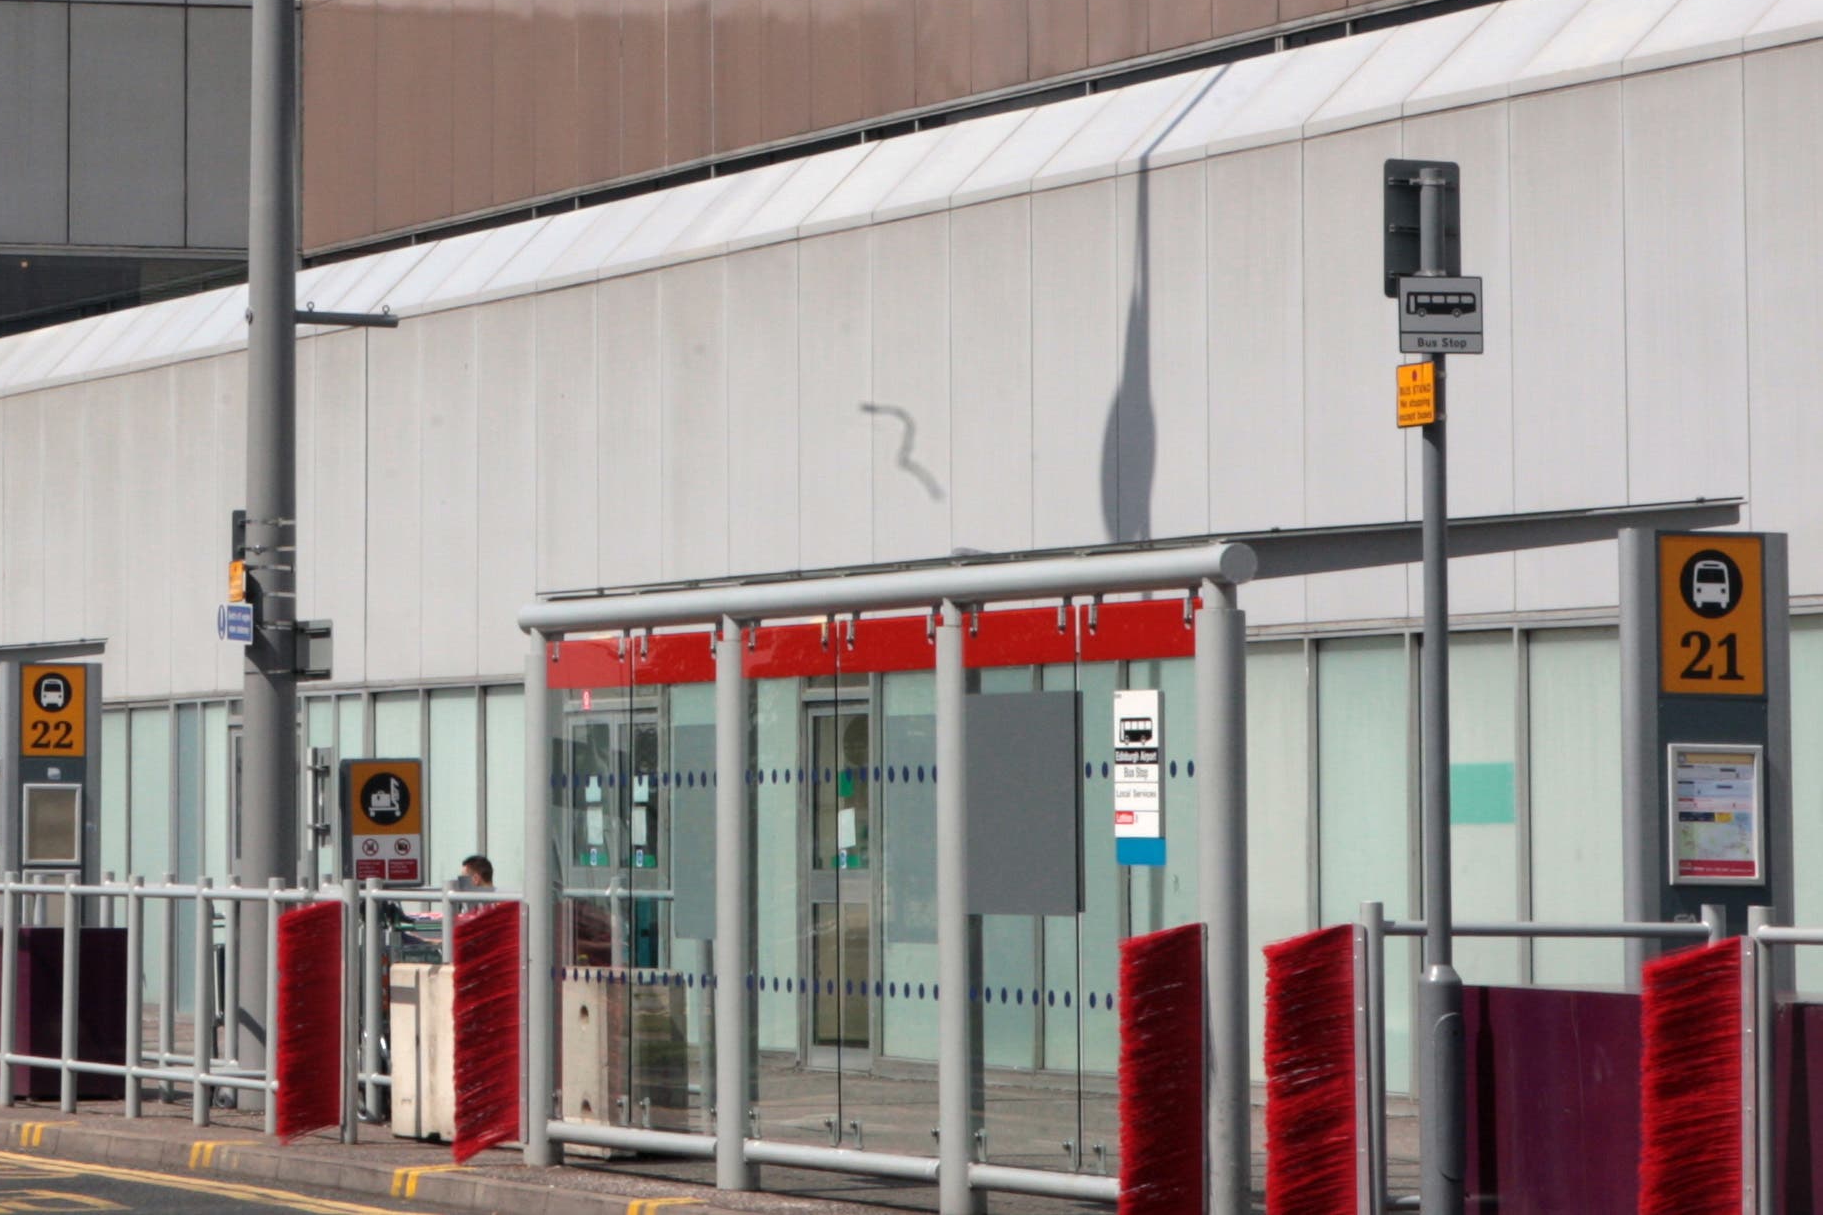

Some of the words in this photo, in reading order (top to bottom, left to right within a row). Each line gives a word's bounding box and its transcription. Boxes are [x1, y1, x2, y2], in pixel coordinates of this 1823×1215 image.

[1417, 337, 1437, 348] Bus
[1441, 337, 1467, 349] Stop
[1680, 630, 1745, 681] 21
[31, 720, 74, 749] 22
[1115, 750, 1139, 763] Edinburgh
[1140, 750, 1157, 762] Airport
[1123, 766, 1135, 778] Bus
[1136, 766, 1148, 780] Stop
[1116, 788, 1130, 798] Local
[1133, 788, 1156, 798] Services
